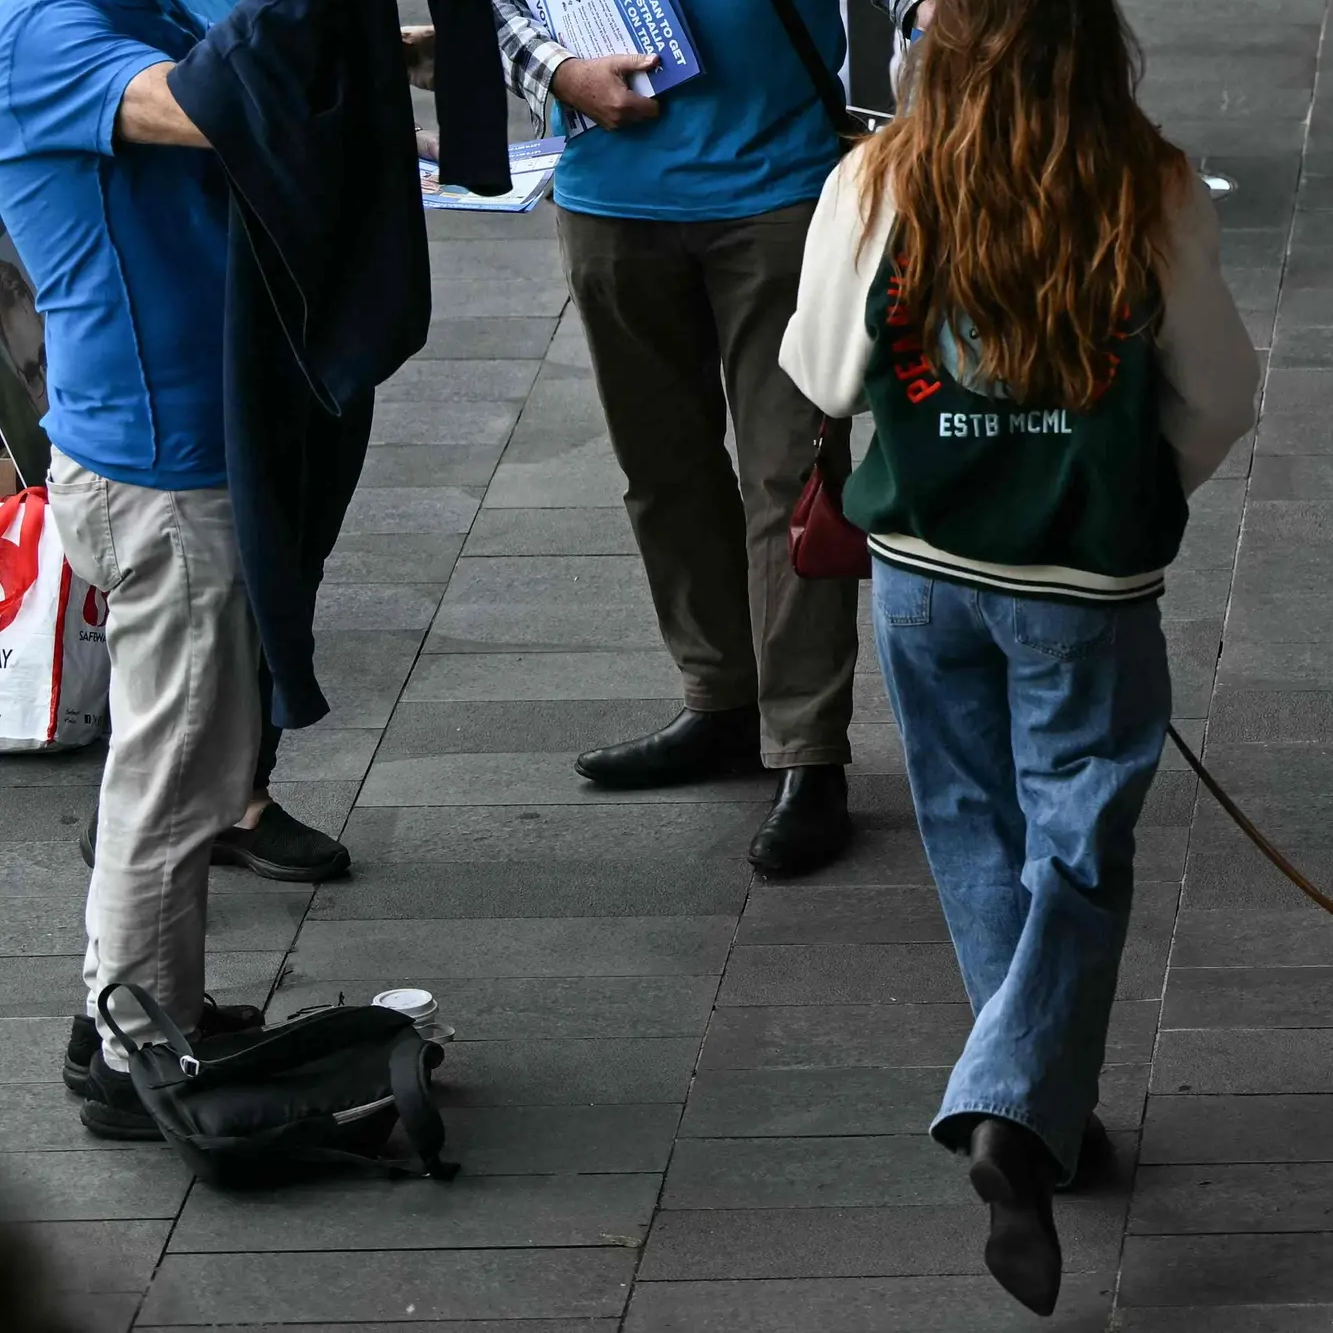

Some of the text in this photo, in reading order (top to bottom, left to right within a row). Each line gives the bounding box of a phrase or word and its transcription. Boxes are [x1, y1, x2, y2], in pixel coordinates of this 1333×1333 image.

[627, 7, 642, 28] ON
[638, 25, 664, 73] TRAK
[660, 18, 673, 39] TO
[668, 37, 687, 66] GET
[939, 409, 1072, 438] ESTB MCML
[79, 630, 107, 642] SAFEWA
